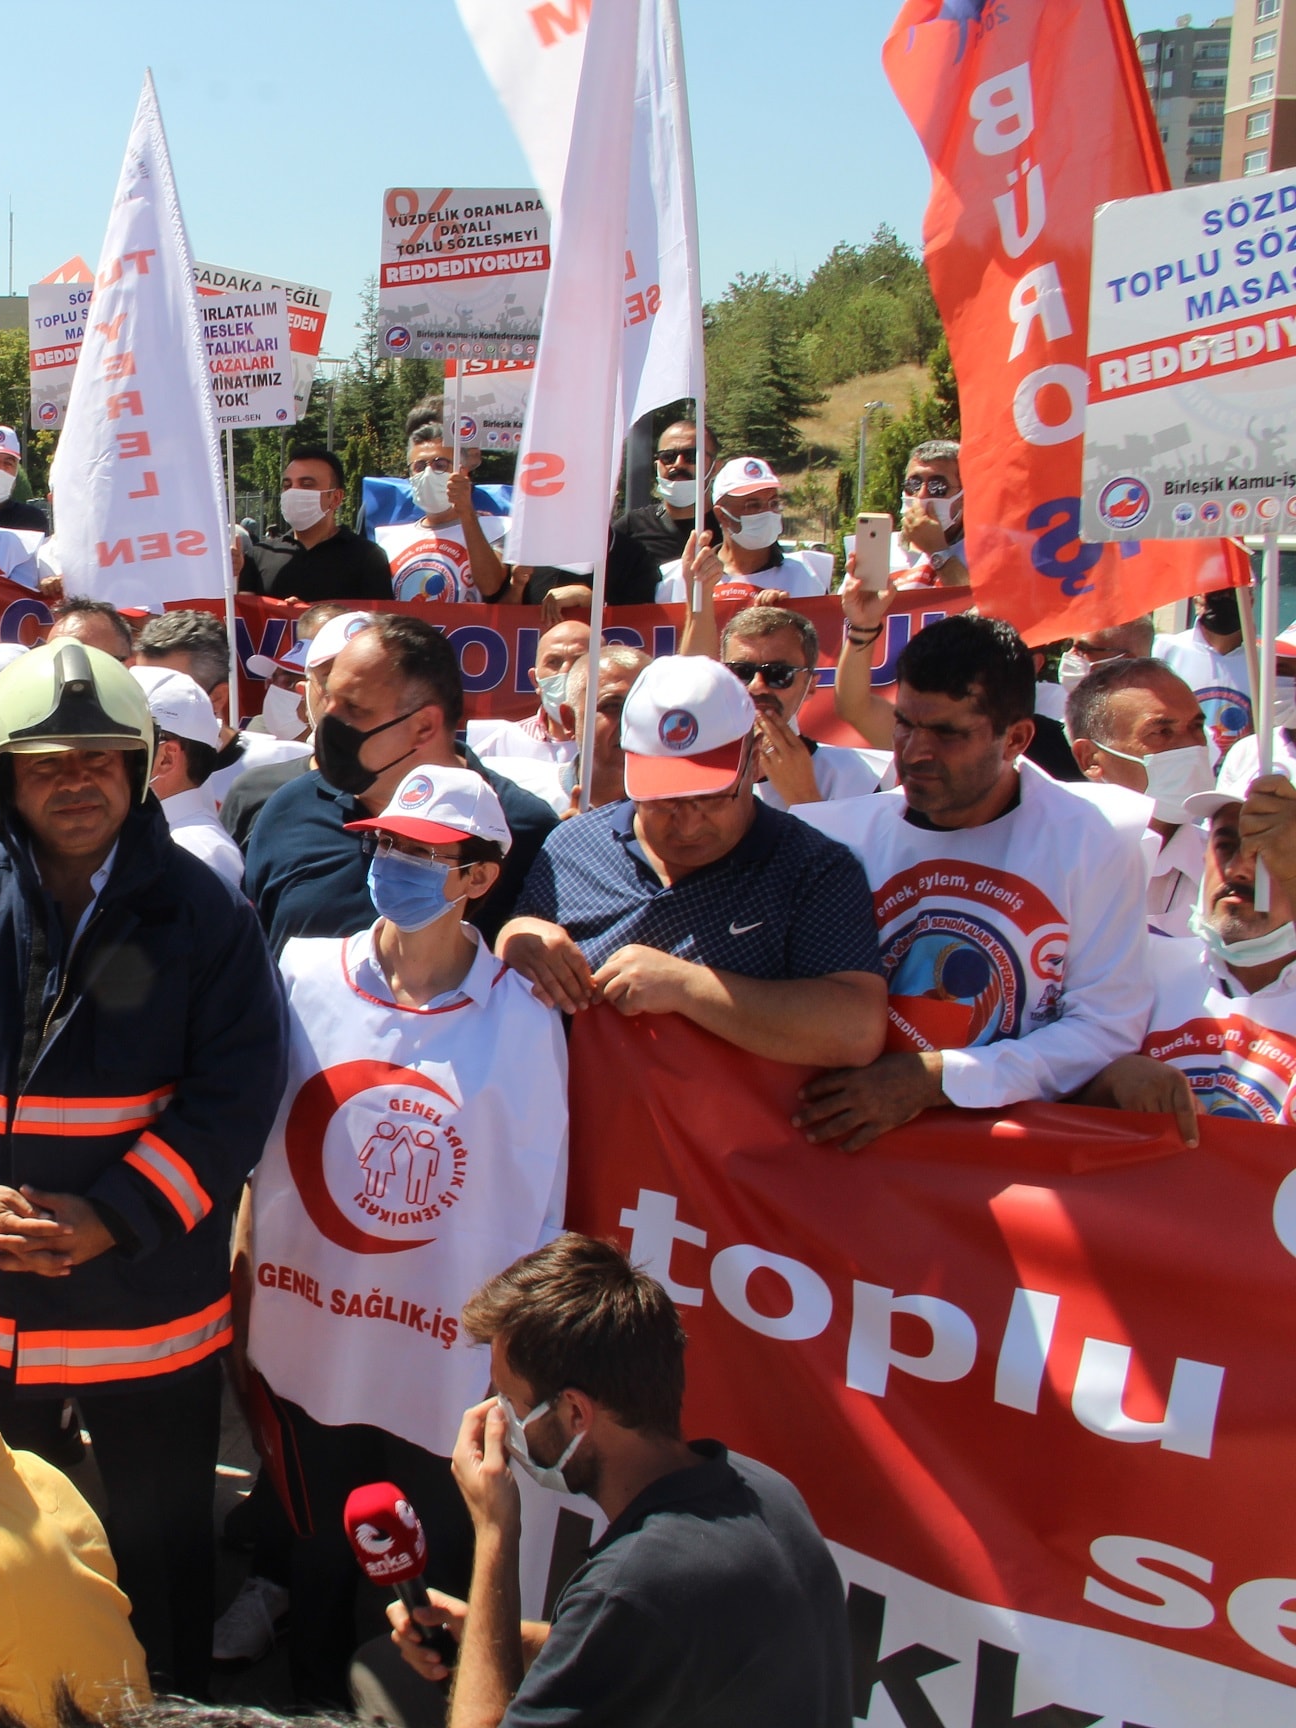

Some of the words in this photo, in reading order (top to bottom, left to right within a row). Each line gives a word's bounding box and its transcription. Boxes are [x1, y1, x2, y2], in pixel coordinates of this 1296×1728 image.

[389, 208, 459, 229] YÜZDELİK
[464, 199, 544, 219] ORANLARA
[440, 220, 491, 236] DAYALI
[396, 241, 443, 256] TOPLU
[448, 227, 538, 250] SÖZLEŞMEYİ
[1106, 248, 1221, 305] TOPLU
[35, 311, 77, 329] TOPLU
[417, 330, 445, 339] Birleşik
[446, 331, 477, 341] Kamu-iş
[215, 393, 249, 408] YOK!
[216, 413, 261, 424] YEREL-SEN
[1164, 477, 1224, 497] Birleşik
[1228, 471, 1296, 492] Kamu-iş
[876, 884, 918, 918] emek,
[918, 872, 970, 892] eylem,
[974, 879, 1025, 913] direniş
[931, 916, 993, 948] SENDİKALARI
[1149, 1032, 1201, 1059] emek,
[389, 1098, 443, 1126] GENEL
[442, 1126, 469, 1189] SAĞLIK
[353, 1191, 441, 1227] SENDİKASI
[437, 1190, 460, 1209] İŞ
[257, 1262, 323, 1309] GENEL
[329, 1286, 458, 1350] SAĞLIK-İŞ
[618, 1186, 1226, 1461] toplu
[365, 1552, 412, 1573] anka
